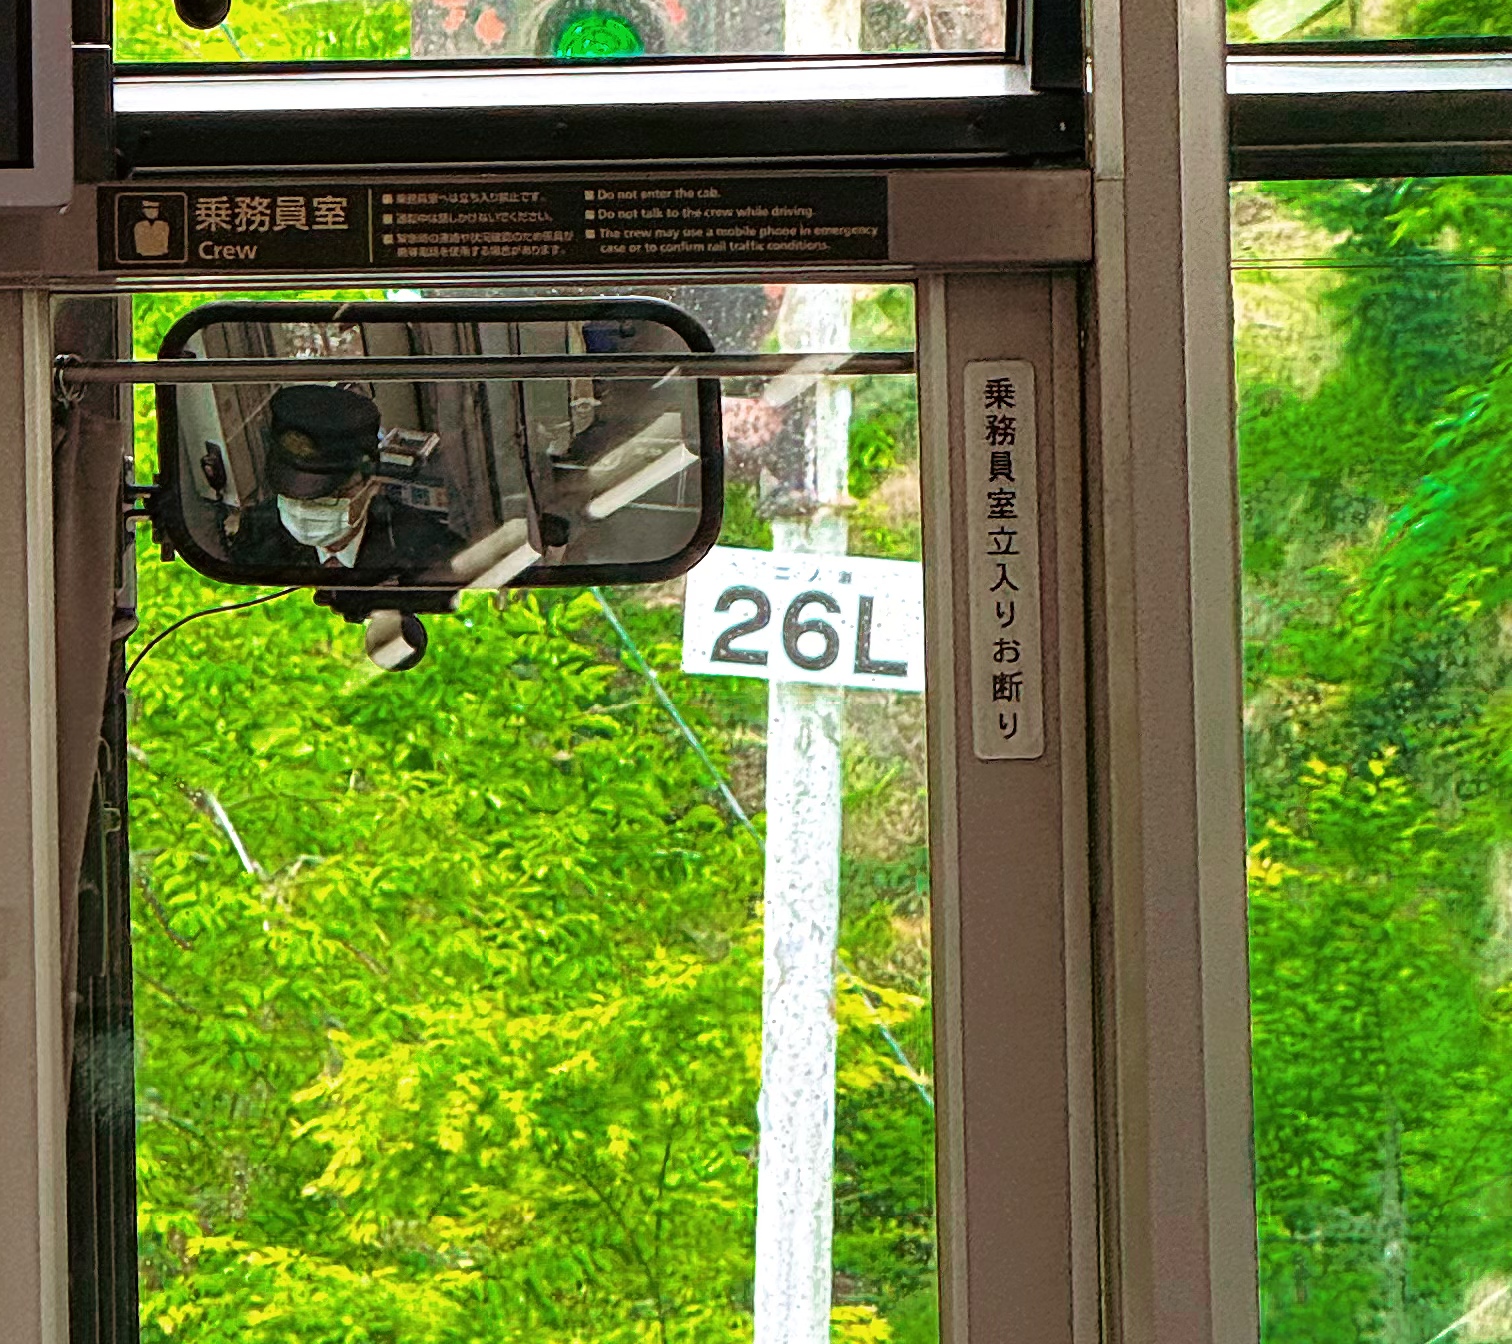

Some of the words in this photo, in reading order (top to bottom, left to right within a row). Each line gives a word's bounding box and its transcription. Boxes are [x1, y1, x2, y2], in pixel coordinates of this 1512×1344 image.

[597, 189, 615, 200] Do
[617, 189, 638, 200] not
[640, 189, 672, 200] enter
[674, 187, 695, 199] the
[194, 195, 349, 232] 乗務員室
[597, 208, 615, 220] Do
[617, 208, 638, 219] not
[641, 207, 663, 219] talk
[666, 207, 679, 218] to
[682, 206, 702, 219] the
[703, 207, 734, 218] crew
[736, 205, 769, 218] while
[600, 227, 621, 238] The
[623, 229, 652, 238] crew
[655, 229, 680, 240] may
[682, 227, 703, 238] use
[705, 227, 714, 237] a
[716, 226, 757, 237] mobile
[799, 225, 811, 236] in
[198, 241, 257, 260] Crew
[600, 244, 626, 254] case
[645, 242, 657, 253] to
[707, 241, 726, 252] rail
[984, 377, 1023, 739] 乗務員室立入りお断り
[710, 585, 908, 677] 26L
